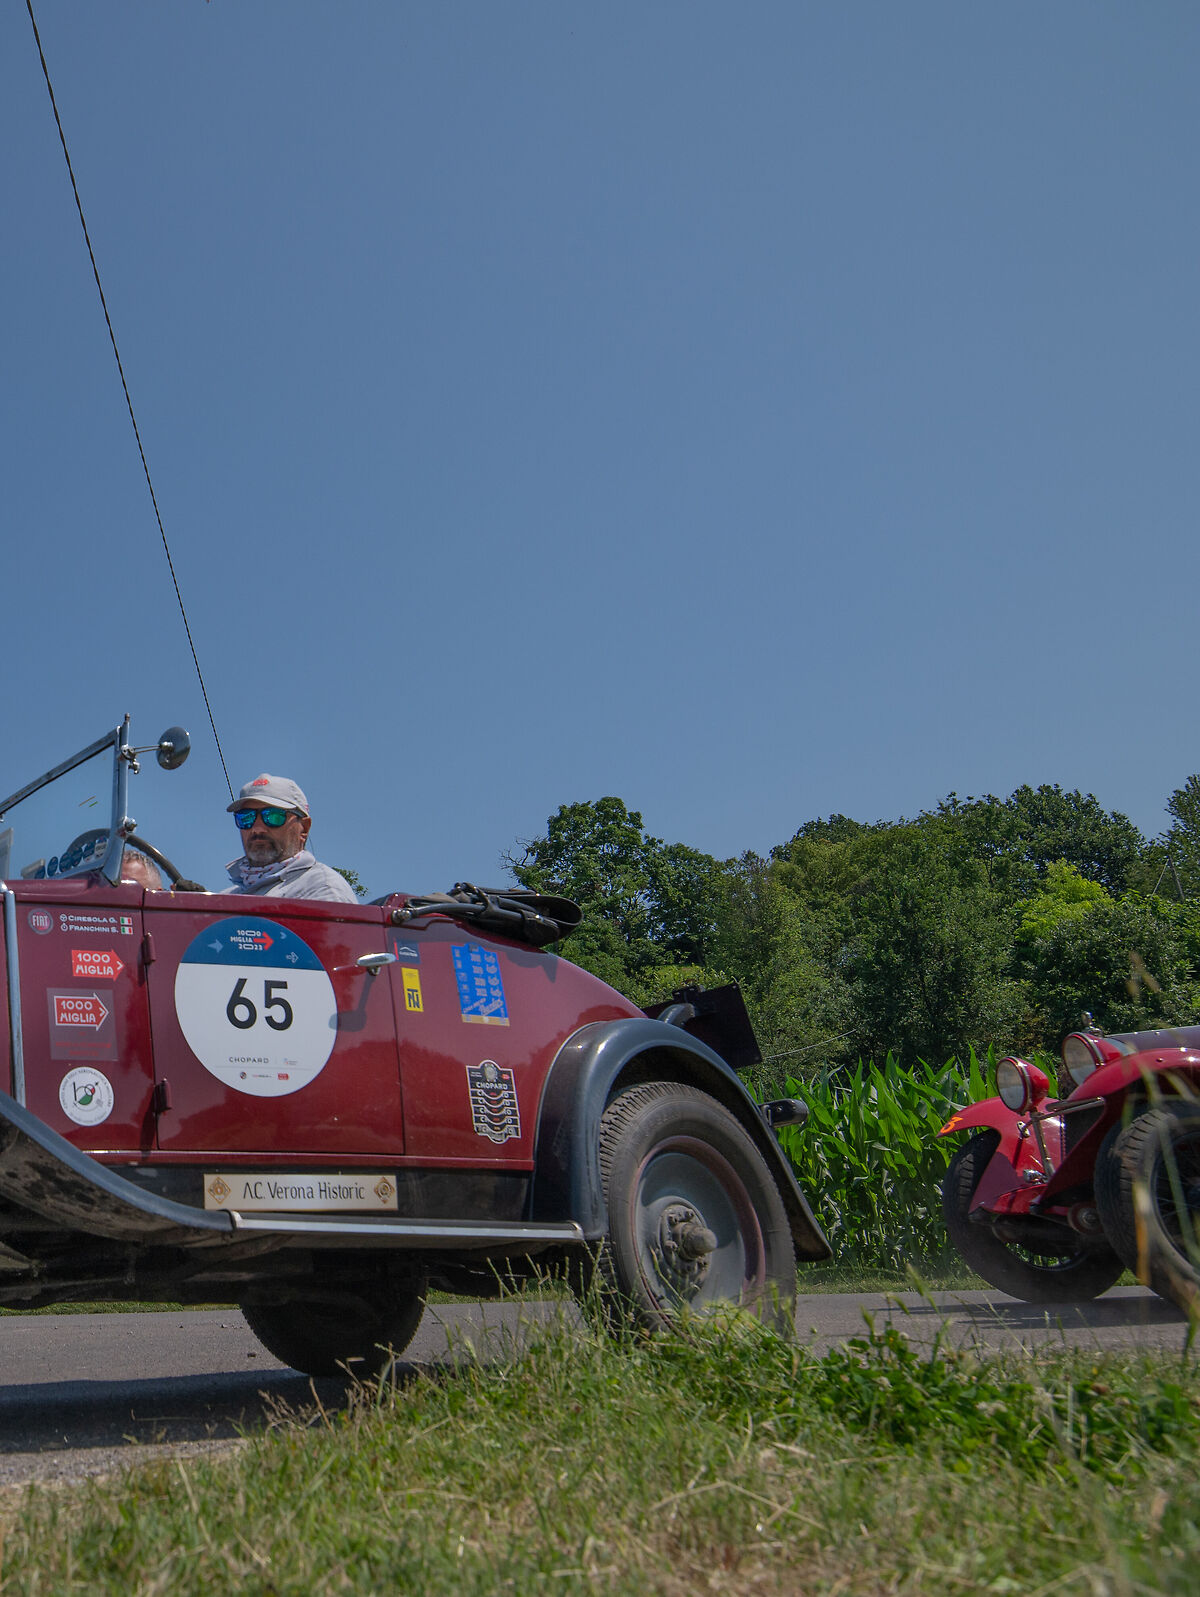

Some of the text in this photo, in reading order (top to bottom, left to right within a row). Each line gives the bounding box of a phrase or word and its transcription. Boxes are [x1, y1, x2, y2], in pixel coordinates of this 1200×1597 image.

[32, 915, 49, 928] FIAT
[68, 915, 108, 923] CIRESOLA
[77, 953, 110, 963] 1000
[76, 965, 114, 975] MIGLIA
[61, 1000, 93, 1010] 1000
[226, 978, 294, 1031] 65
[60, 1012, 96, 1023] MIGLIA
[228, 1056, 270, 1064] CHOPARD
[476, 1082, 508, 1090] CHOPARD
[267, 1182, 314, 1199] Verona
[318, 1182, 365, 1200] Historic
